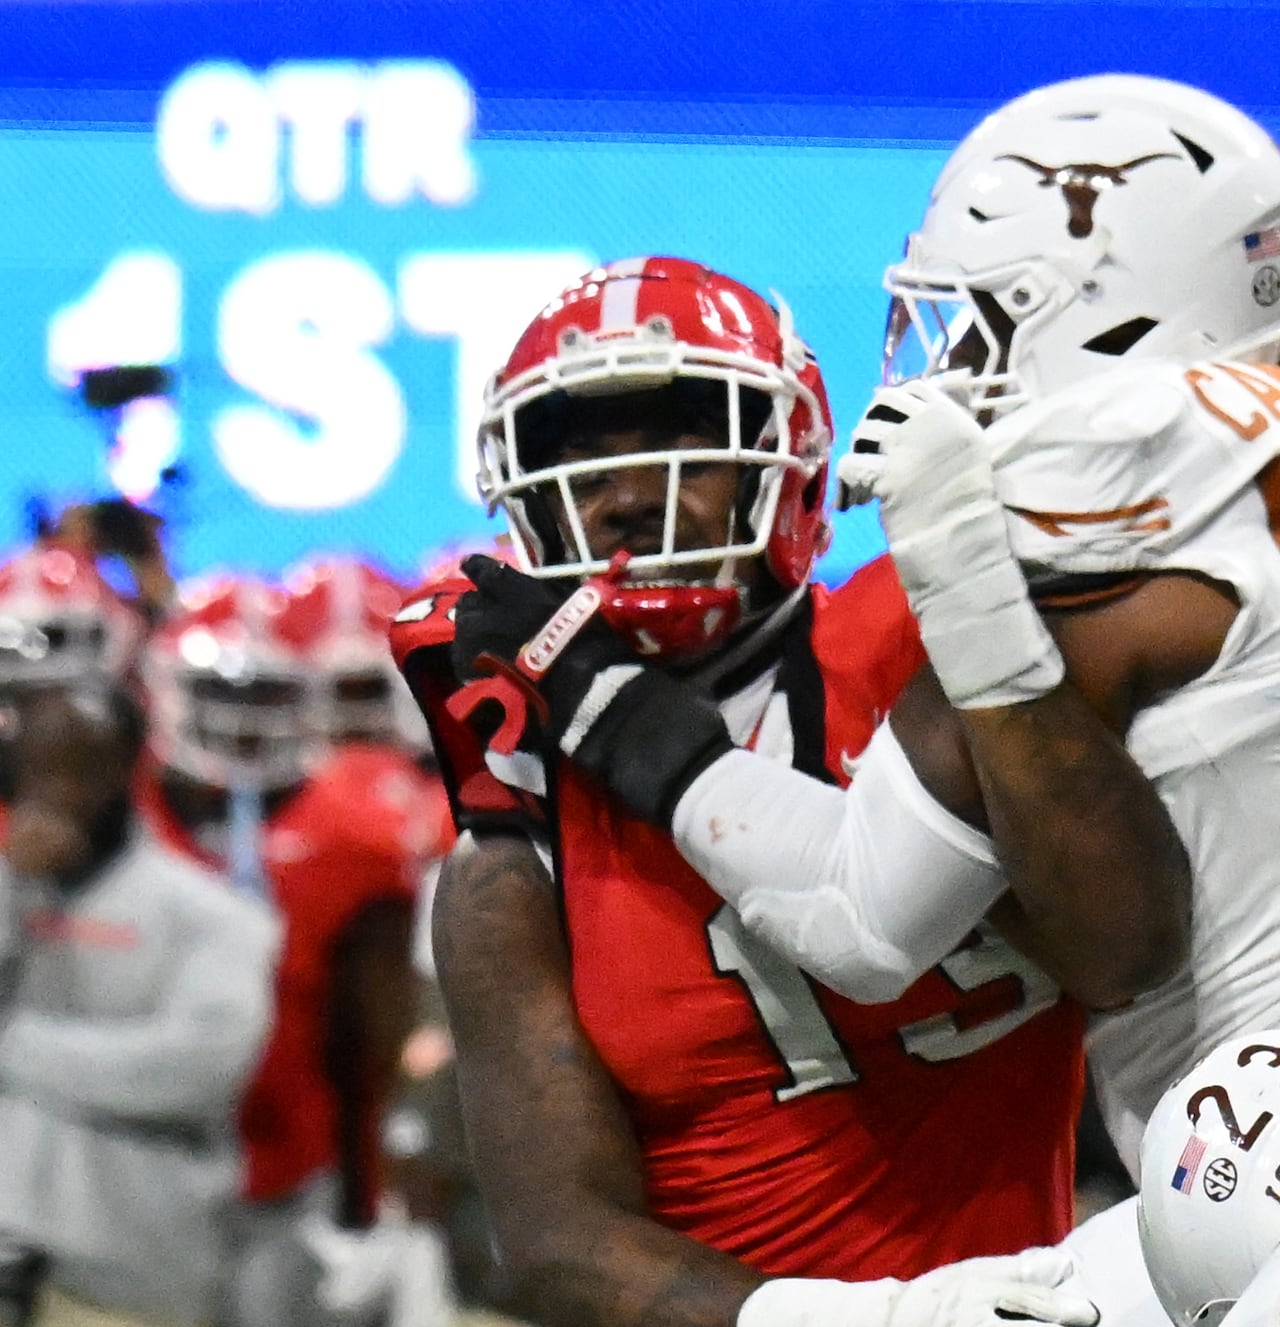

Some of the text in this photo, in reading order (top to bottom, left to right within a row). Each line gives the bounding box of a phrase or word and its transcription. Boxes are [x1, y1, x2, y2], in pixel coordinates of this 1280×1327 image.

[157, 60, 478, 214] QTR
[48, 250, 602, 508] 1ST
[1202, 1157, 1239, 1202] SEC
